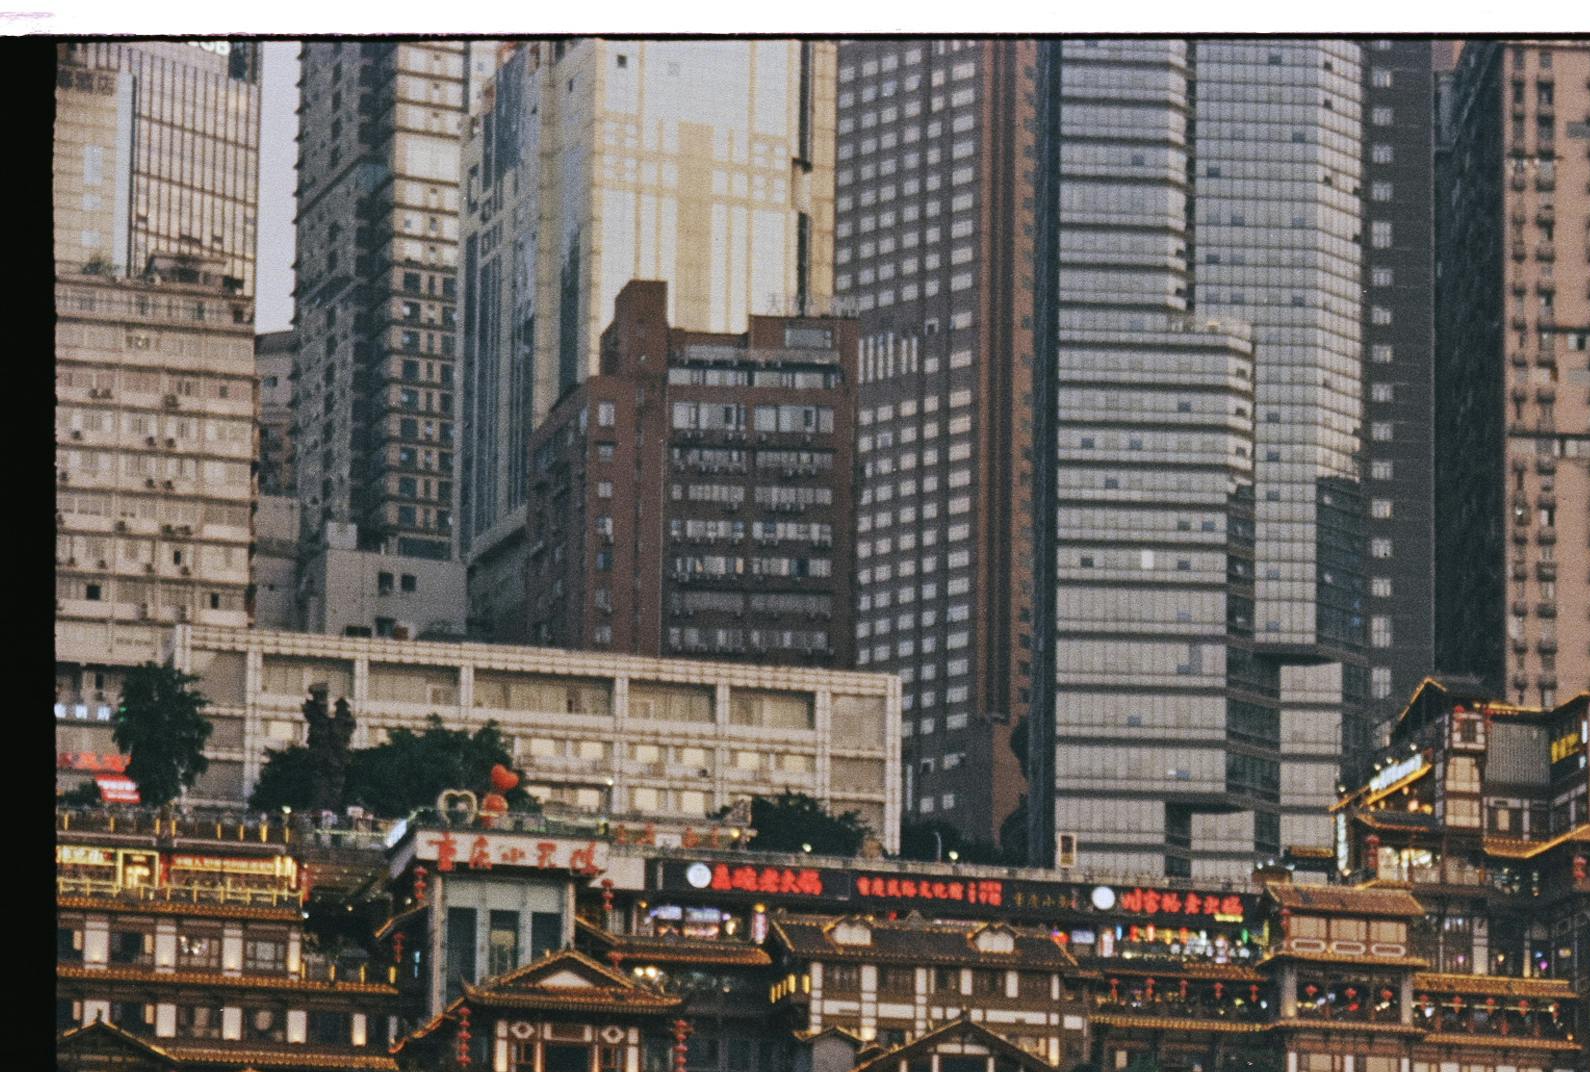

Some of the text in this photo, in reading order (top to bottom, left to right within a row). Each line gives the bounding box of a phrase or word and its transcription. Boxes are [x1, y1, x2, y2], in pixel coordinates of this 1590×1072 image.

[427, 831, 601, 875] 重庆小天鹅
